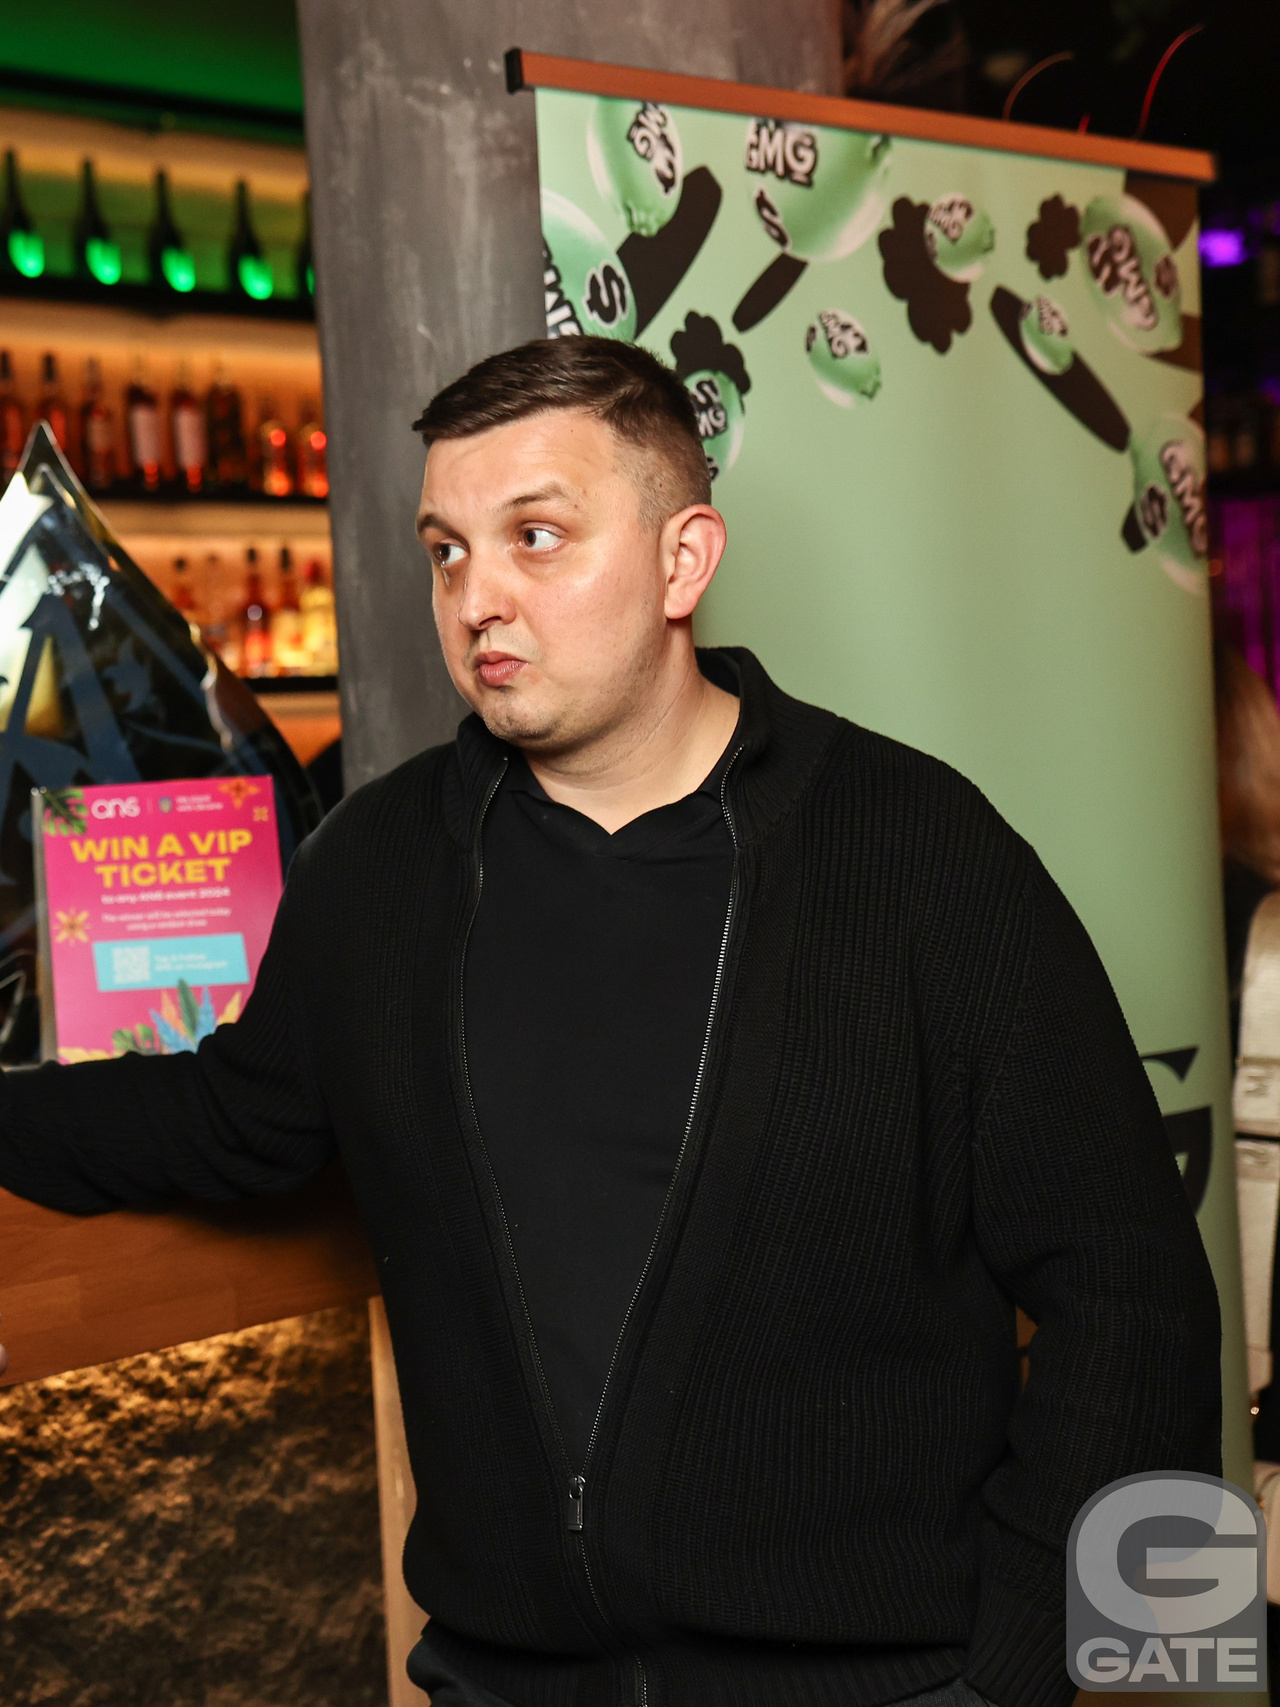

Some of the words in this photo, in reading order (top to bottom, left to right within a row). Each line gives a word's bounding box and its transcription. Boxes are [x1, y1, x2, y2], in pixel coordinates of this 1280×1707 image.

[71, 835, 150, 863] WIN
[157, 833, 185, 857] A
[189, 829, 253, 855] VIP
[94, 857, 231, 888] TICKET
